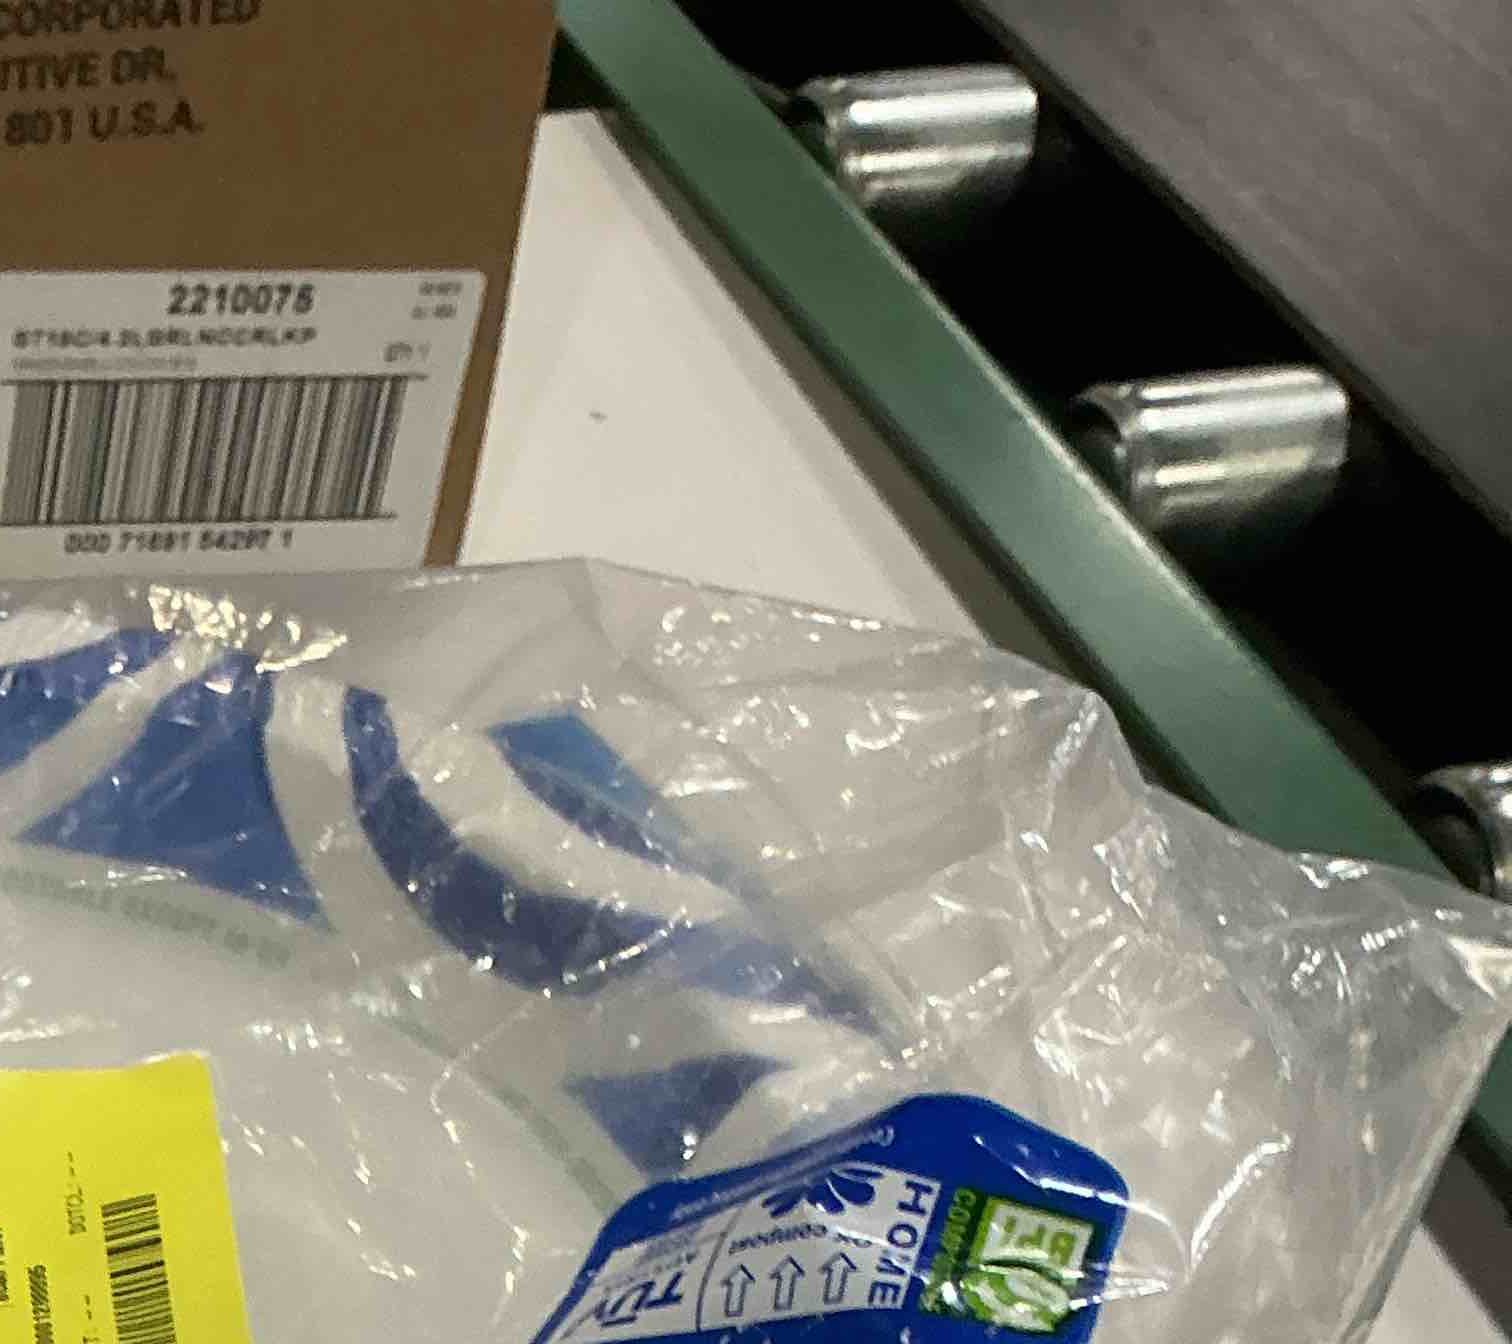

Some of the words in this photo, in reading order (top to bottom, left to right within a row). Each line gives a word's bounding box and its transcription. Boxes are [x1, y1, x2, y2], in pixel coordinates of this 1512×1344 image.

[110, 46, 177, 86] DR.
[90, 100, 206, 143] U.S.A.
[868, 1179, 934, 1307] HOME
